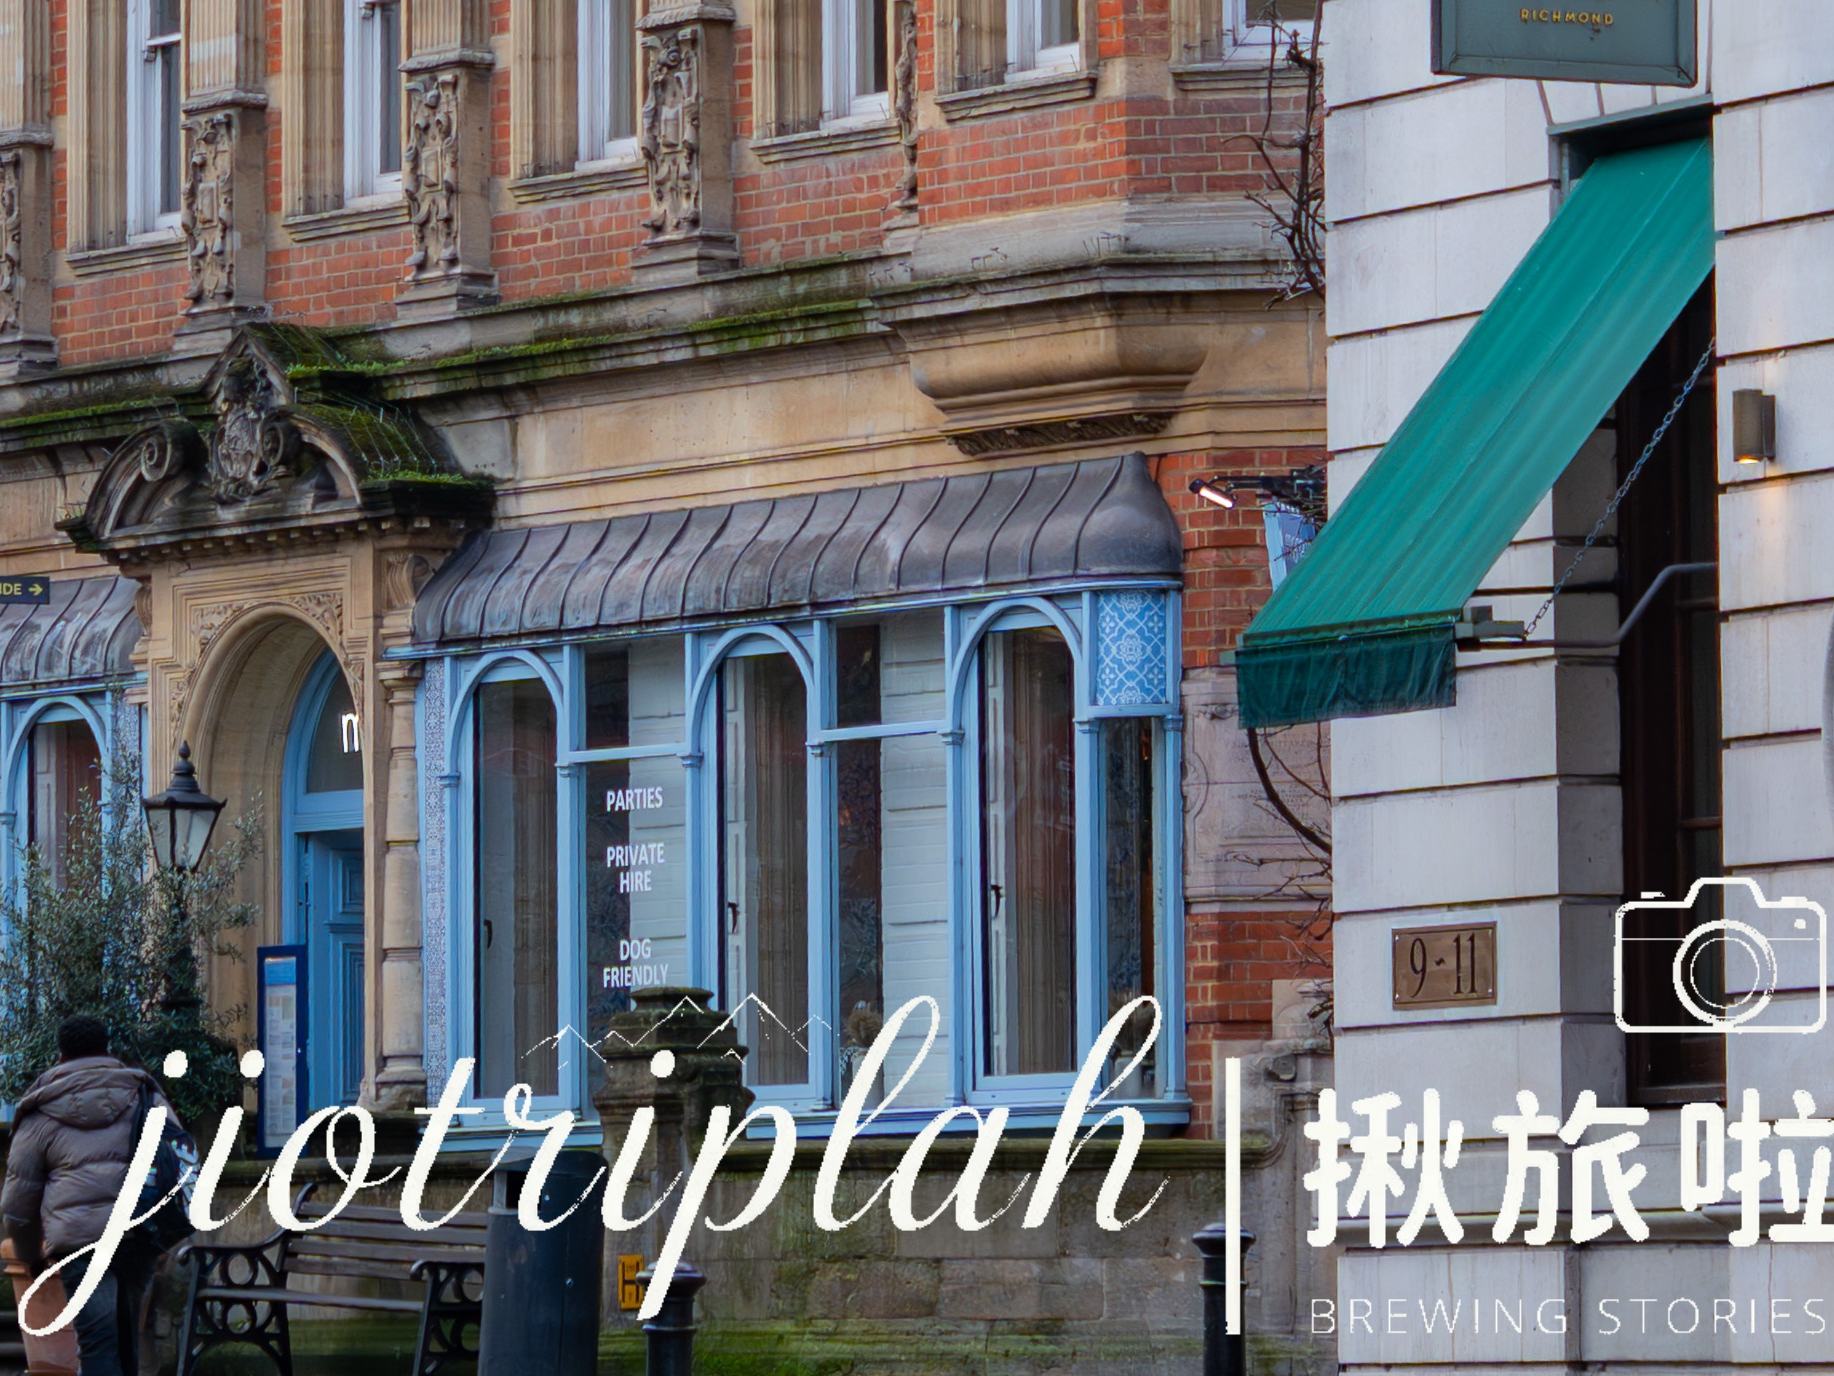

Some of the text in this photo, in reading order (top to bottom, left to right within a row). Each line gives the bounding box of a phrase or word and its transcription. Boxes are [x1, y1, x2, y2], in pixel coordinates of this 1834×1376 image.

[1519, 8, 1615, 27] RICHMOND
[605, 786, 664, 812] PARTIES
[606, 842, 665, 868] PRIVATE
[618, 870, 652, 894] HIRE
[618, 938, 652, 961] DOG
[603, 963, 669, 989] FRIENDLY
[1410, 932, 1478, 999] 9-11
